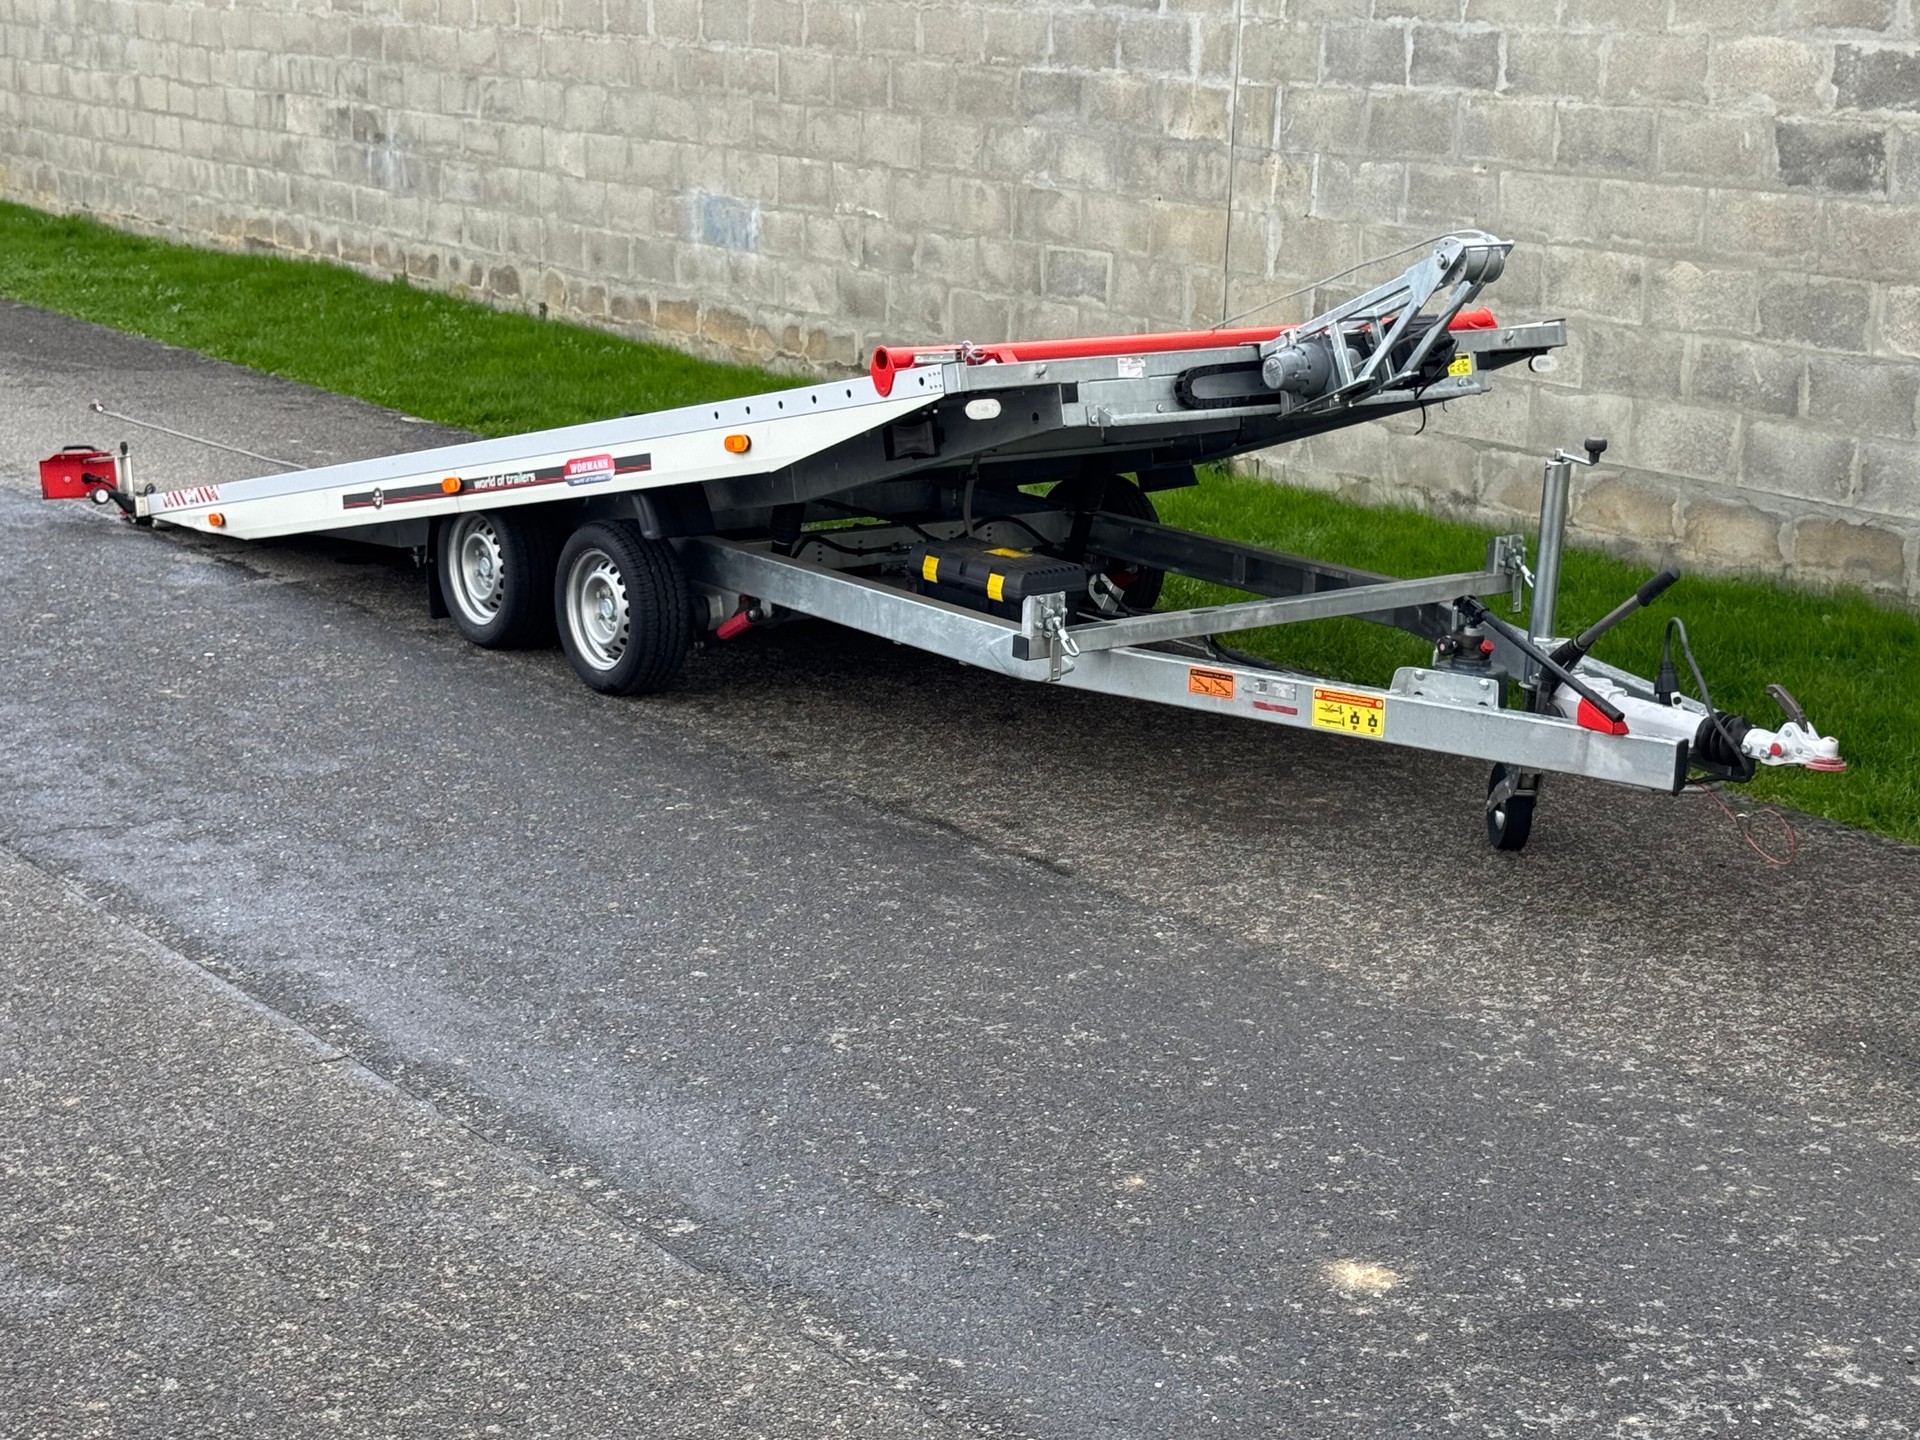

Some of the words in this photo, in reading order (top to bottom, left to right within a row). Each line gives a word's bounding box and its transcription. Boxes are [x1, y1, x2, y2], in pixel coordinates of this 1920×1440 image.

[474, 476, 496, 489] world
[497, 474, 505, 486] of
[506, 471, 536, 485] trailers
